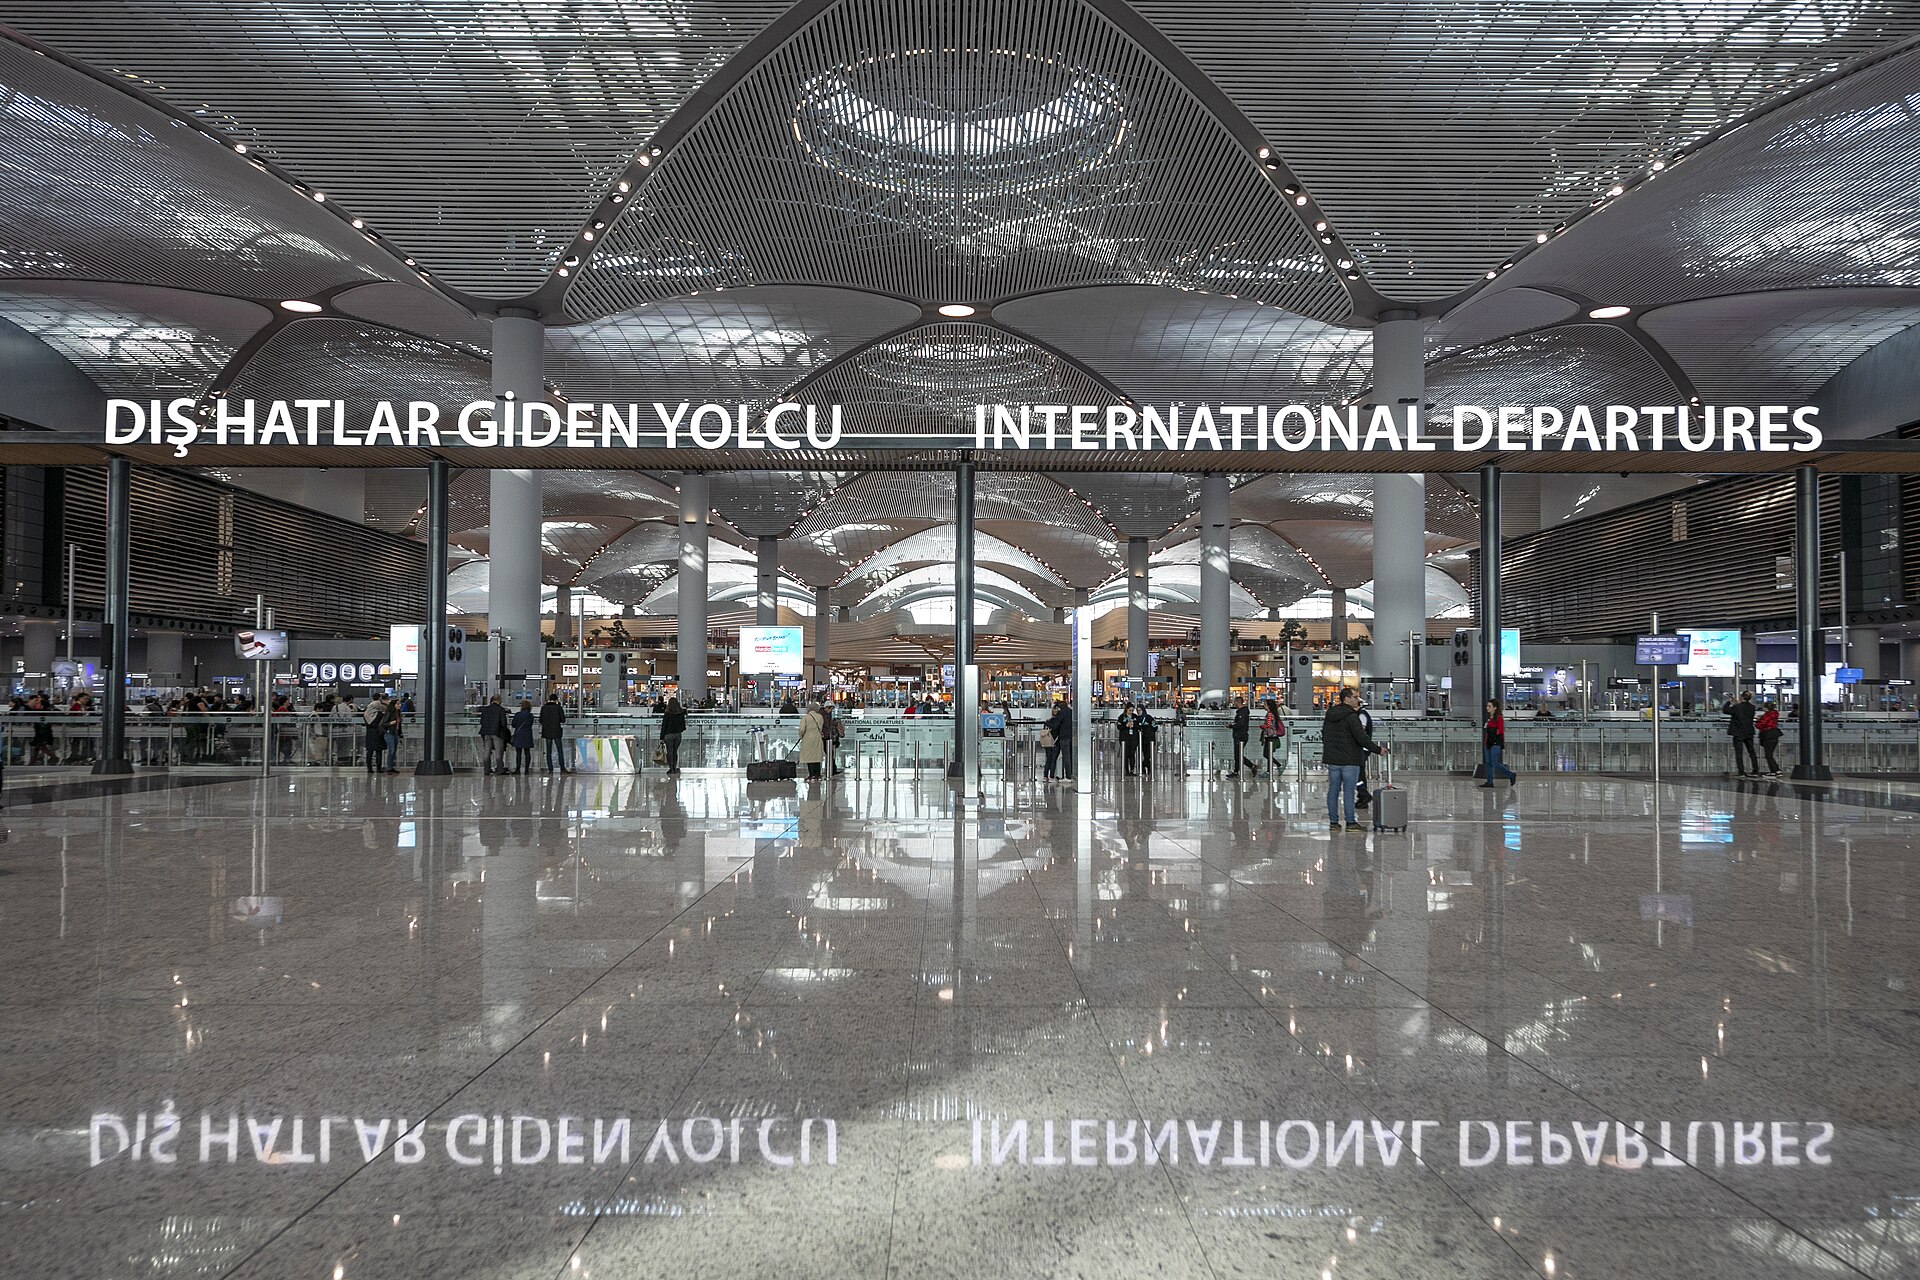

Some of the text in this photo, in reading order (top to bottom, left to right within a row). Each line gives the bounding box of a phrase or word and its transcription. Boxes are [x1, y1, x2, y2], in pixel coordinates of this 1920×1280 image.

[105, 390, 843, 458] DIŞ HATLAR GİDEN YOLCU
[974, 404, 1824, 453] INTERNATIONAL DEPARTURES
